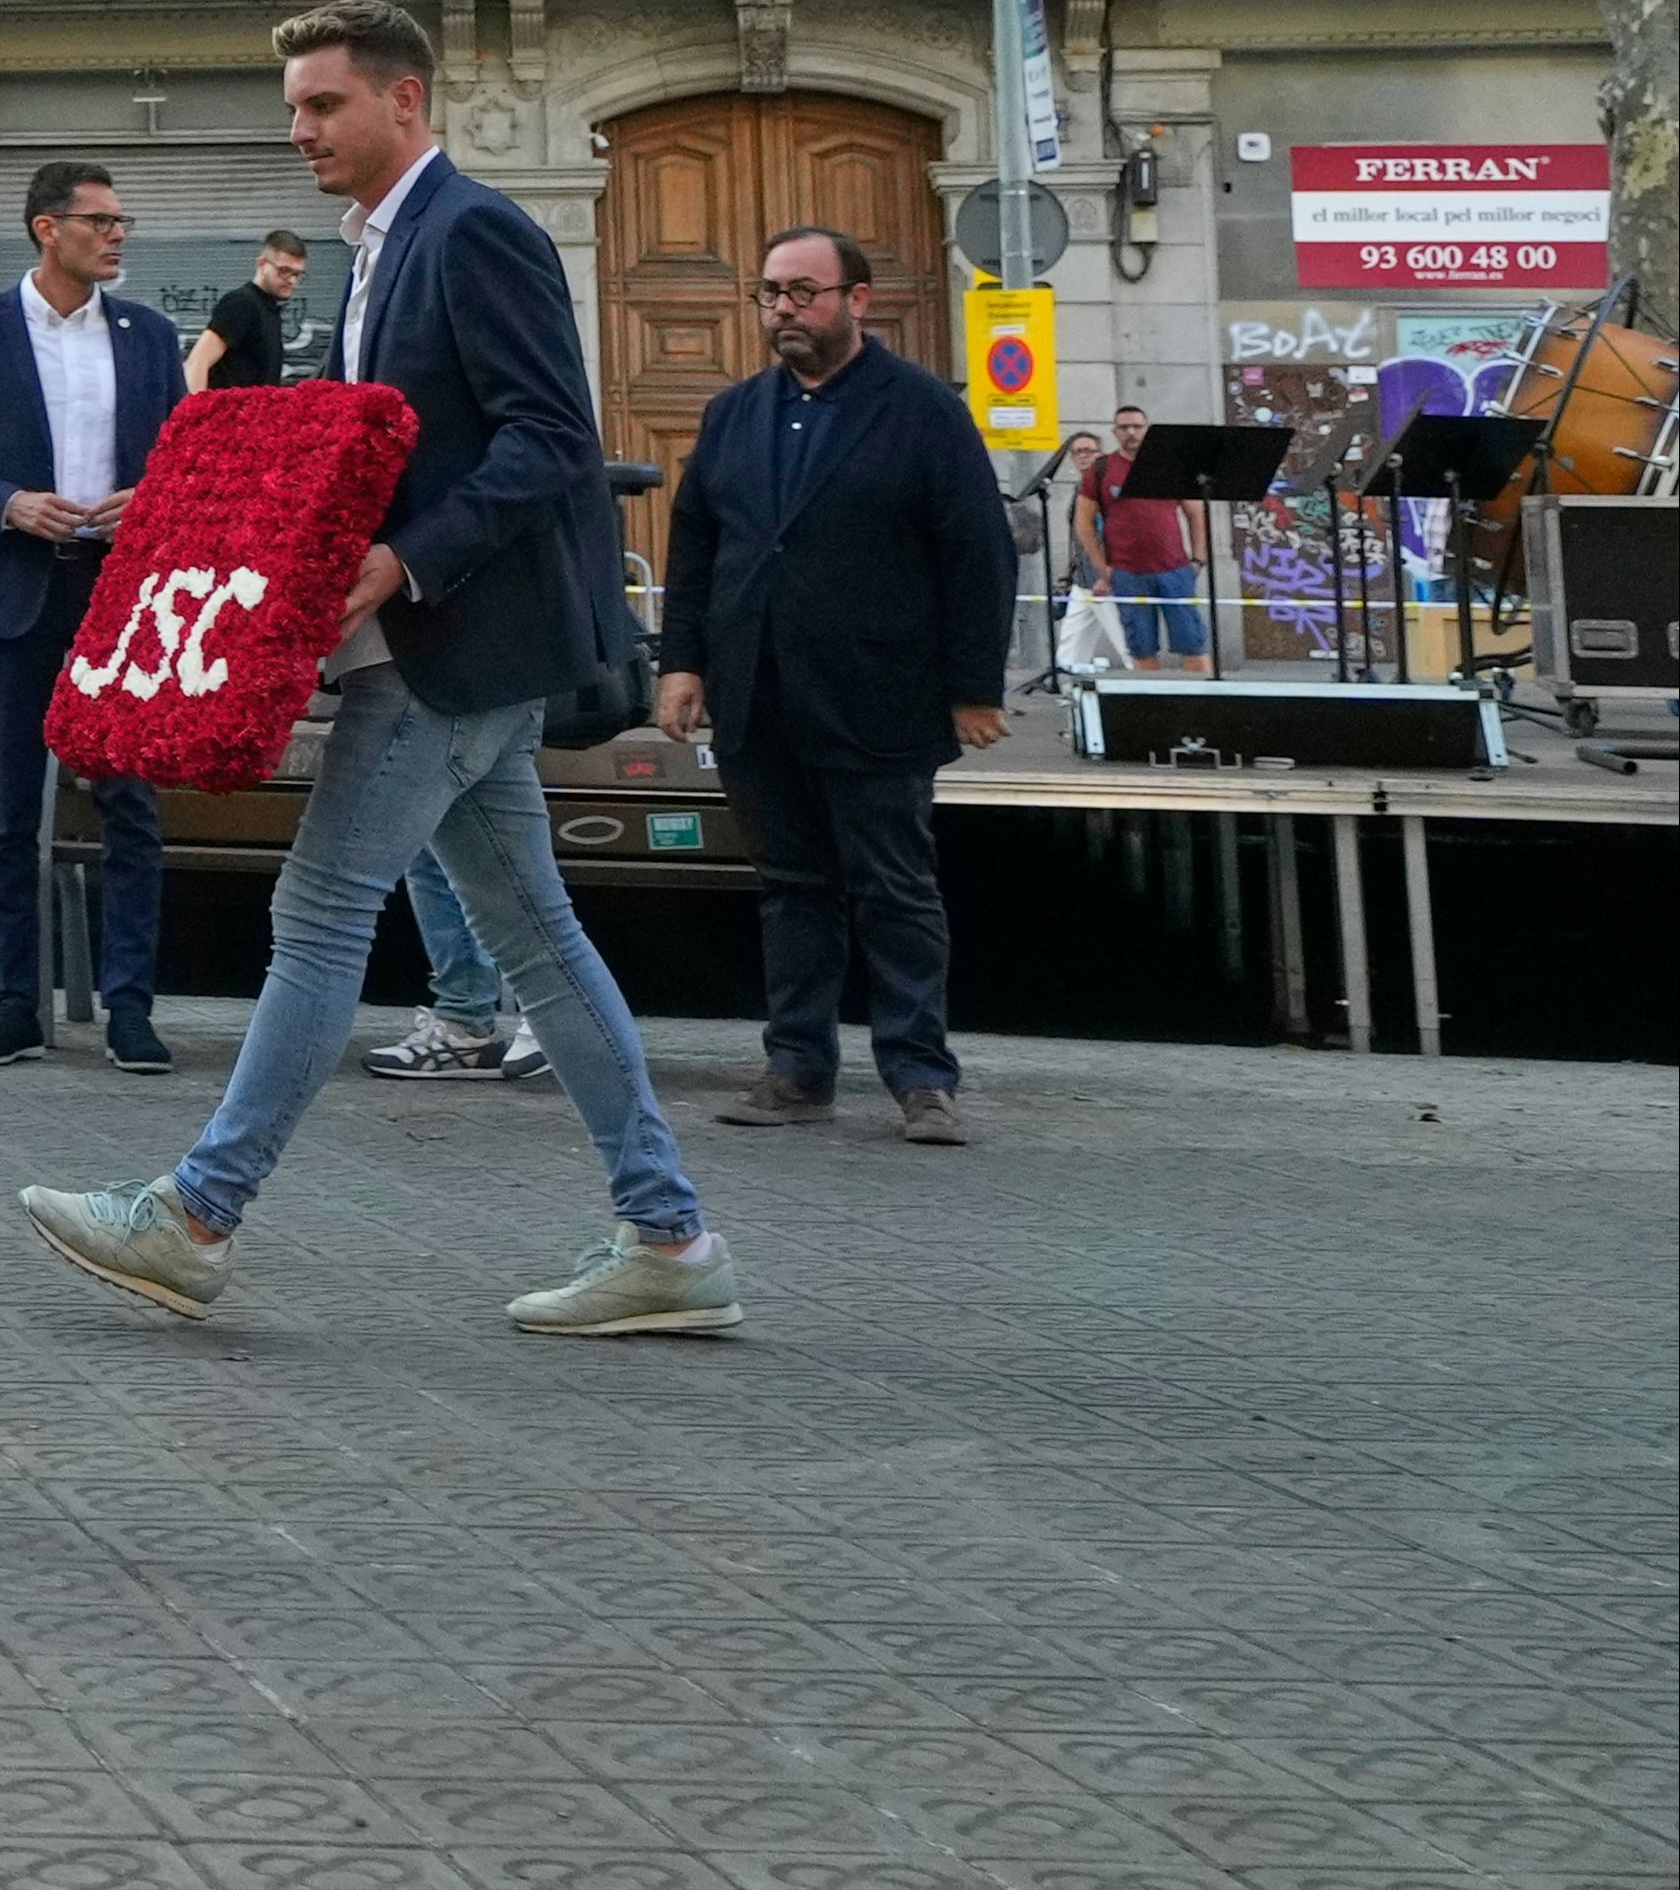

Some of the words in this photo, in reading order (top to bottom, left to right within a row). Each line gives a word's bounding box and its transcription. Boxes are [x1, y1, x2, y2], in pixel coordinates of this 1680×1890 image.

[1312, 208, 1327, 222] el
[1334, 208, 1388, 222] millor
[1395, 208, 1437, 222] local
[1445, 208, 1471, 225] pel
[1478, 207, 1532, 222] millor
[1541, 207, 1601, 224] negoci
[1360, 246, 1397, 269] 93
[1406, 246, 1462, 269] 600
[1470, 246, 1508, 269] 48
[1517, 246, 1556, 269] 00
[70, 566, 268, 701] JSC
